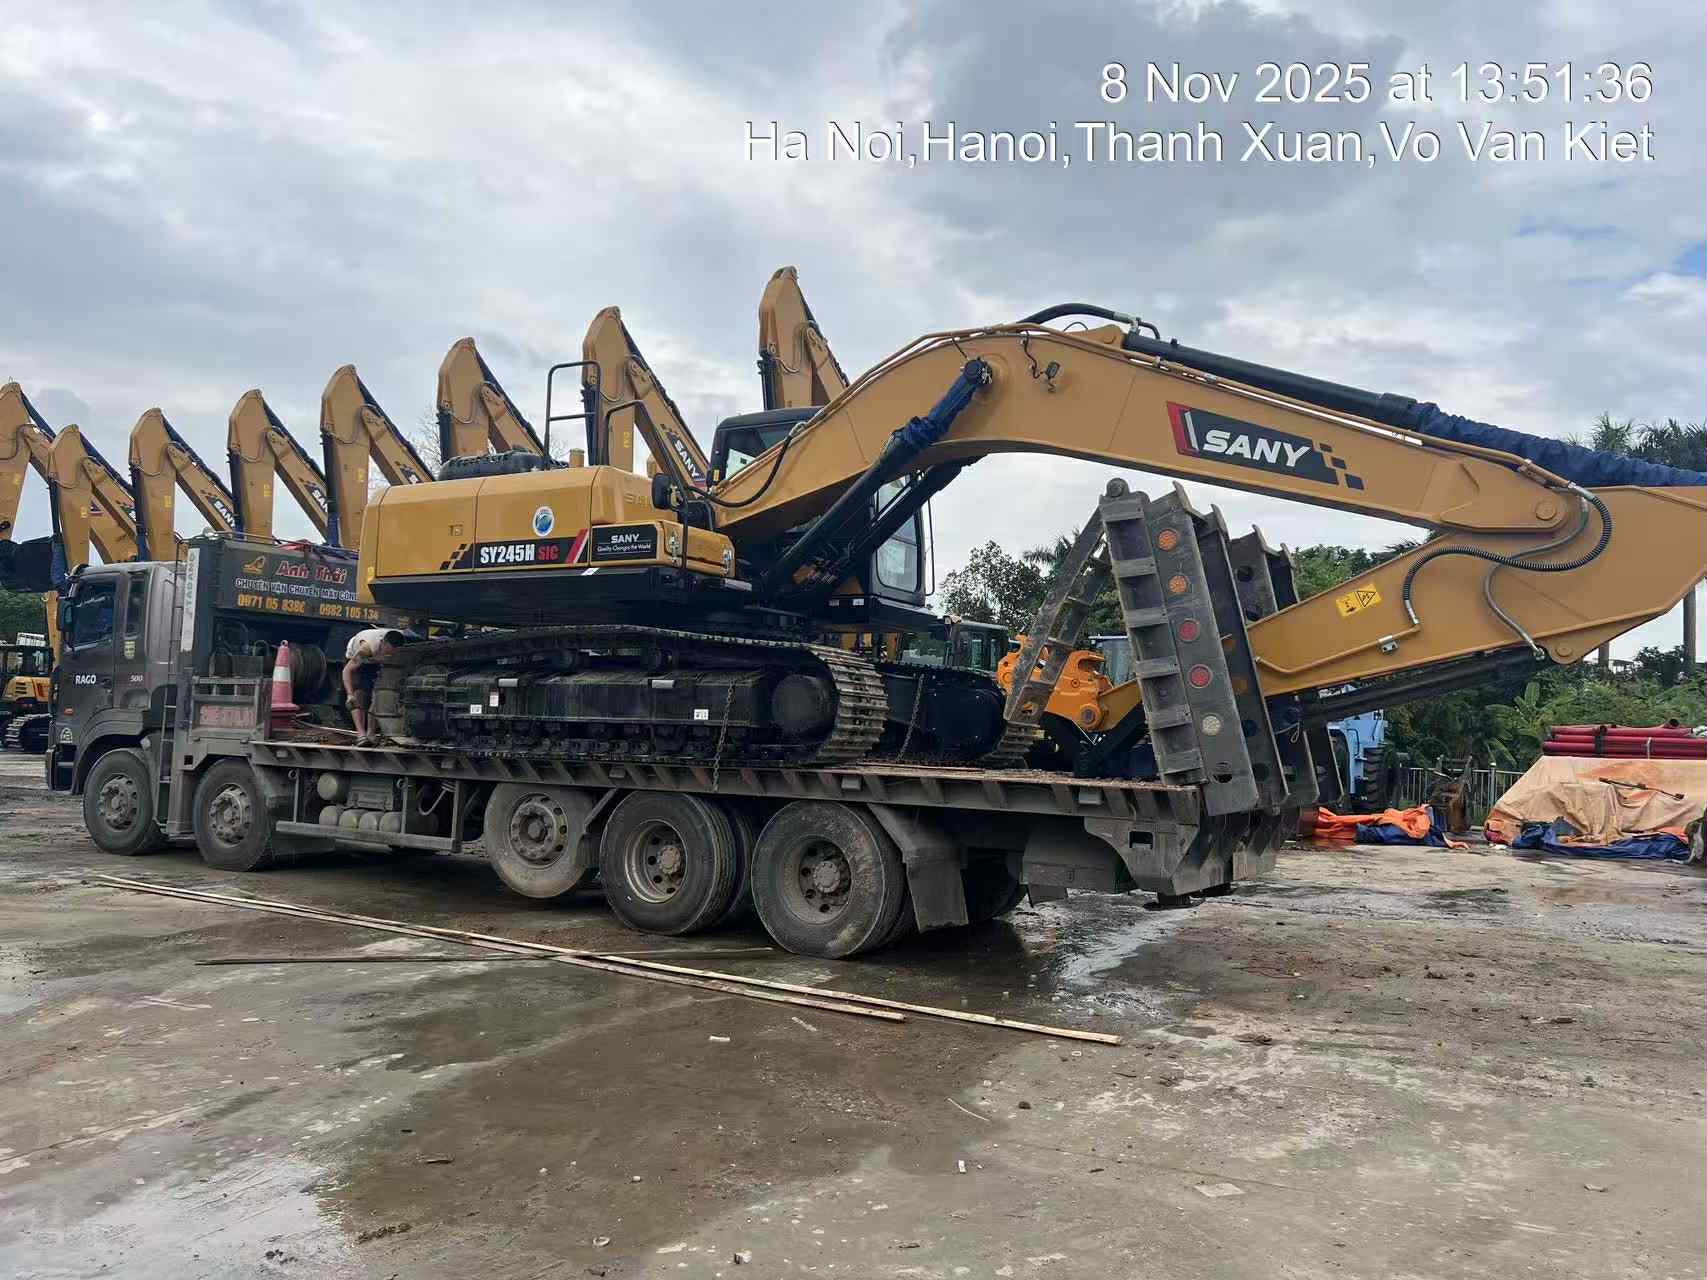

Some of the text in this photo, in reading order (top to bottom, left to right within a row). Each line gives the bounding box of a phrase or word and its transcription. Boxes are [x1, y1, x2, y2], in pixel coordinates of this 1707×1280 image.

[1203, 428, 1310, 468] SANY
[674, 439, 700, 478] SANY
[610, 533, 640, 544] SANY
[480, 543, 559, 564] SY245H SIC
[275, 560, 310, 579] Anh
[265, 597, 278, 610] 05
